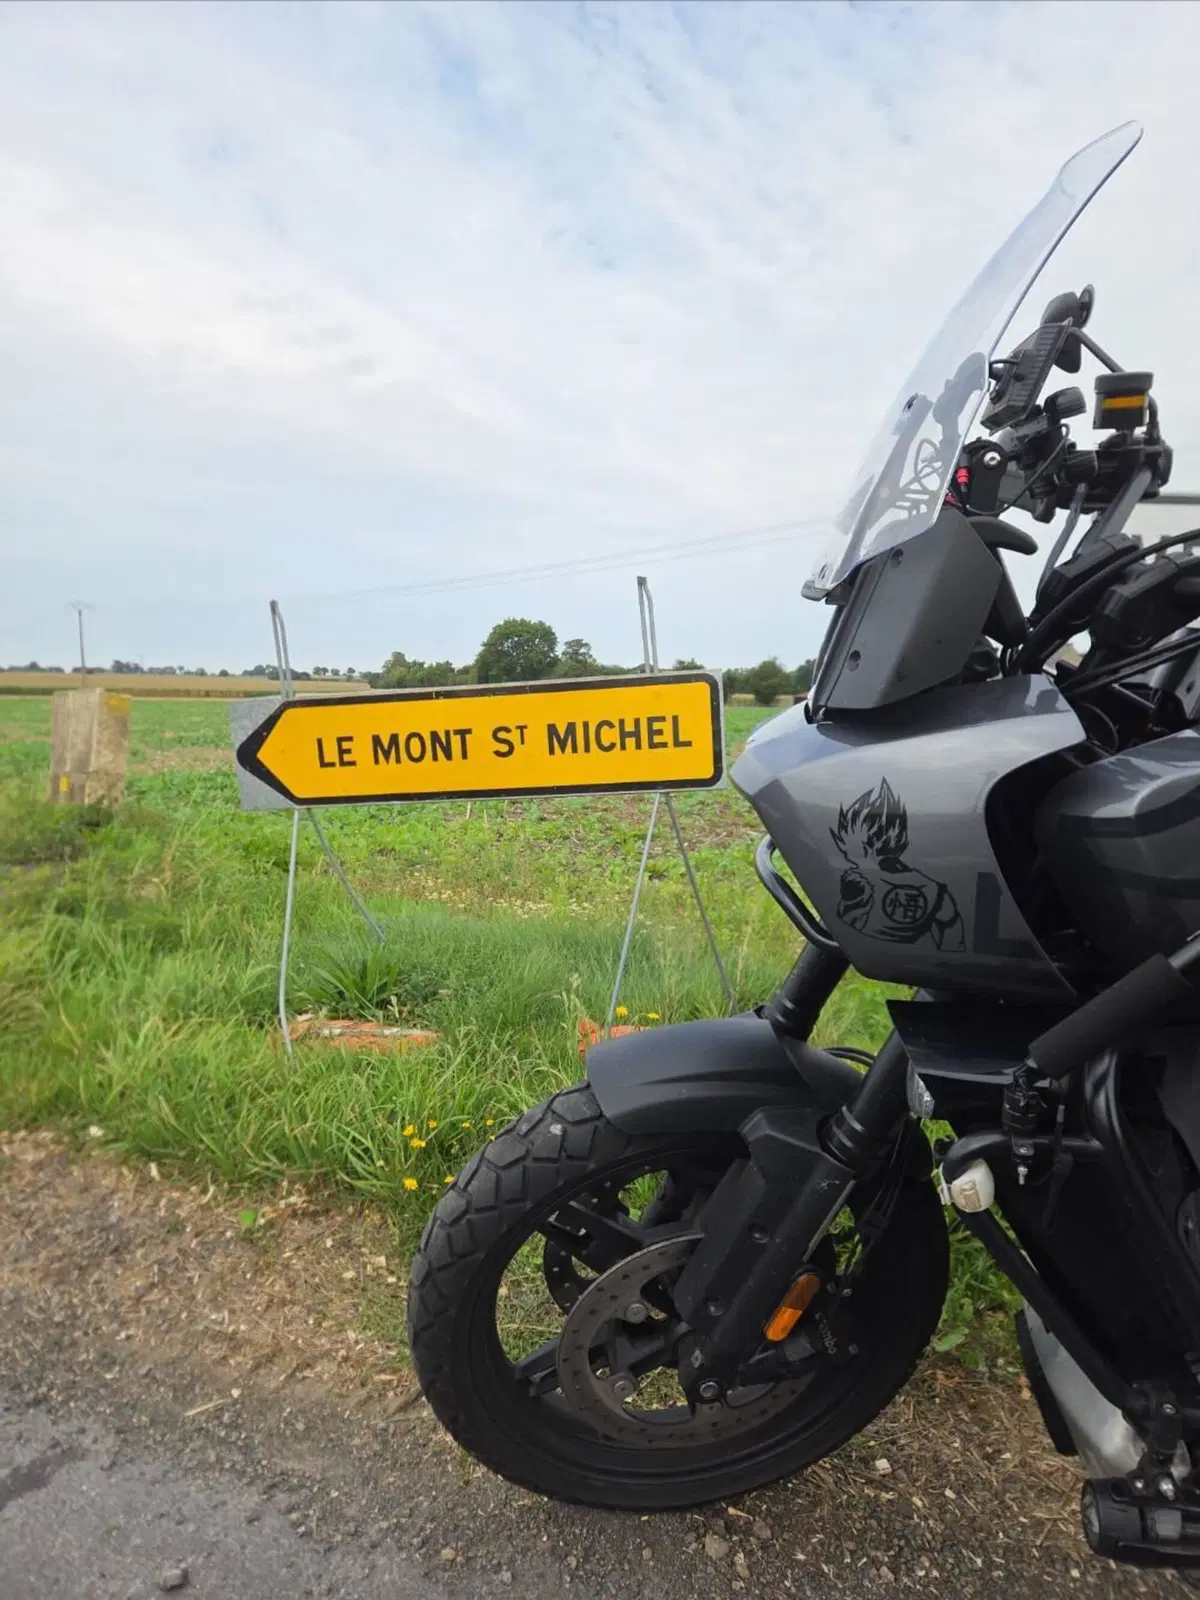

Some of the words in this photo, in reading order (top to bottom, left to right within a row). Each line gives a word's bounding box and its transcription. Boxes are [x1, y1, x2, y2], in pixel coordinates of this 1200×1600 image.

[316, 736, 356, 768] LE
[372, 728, 473, 765] MONT
[547, 715, 692, 755] MICHEL
